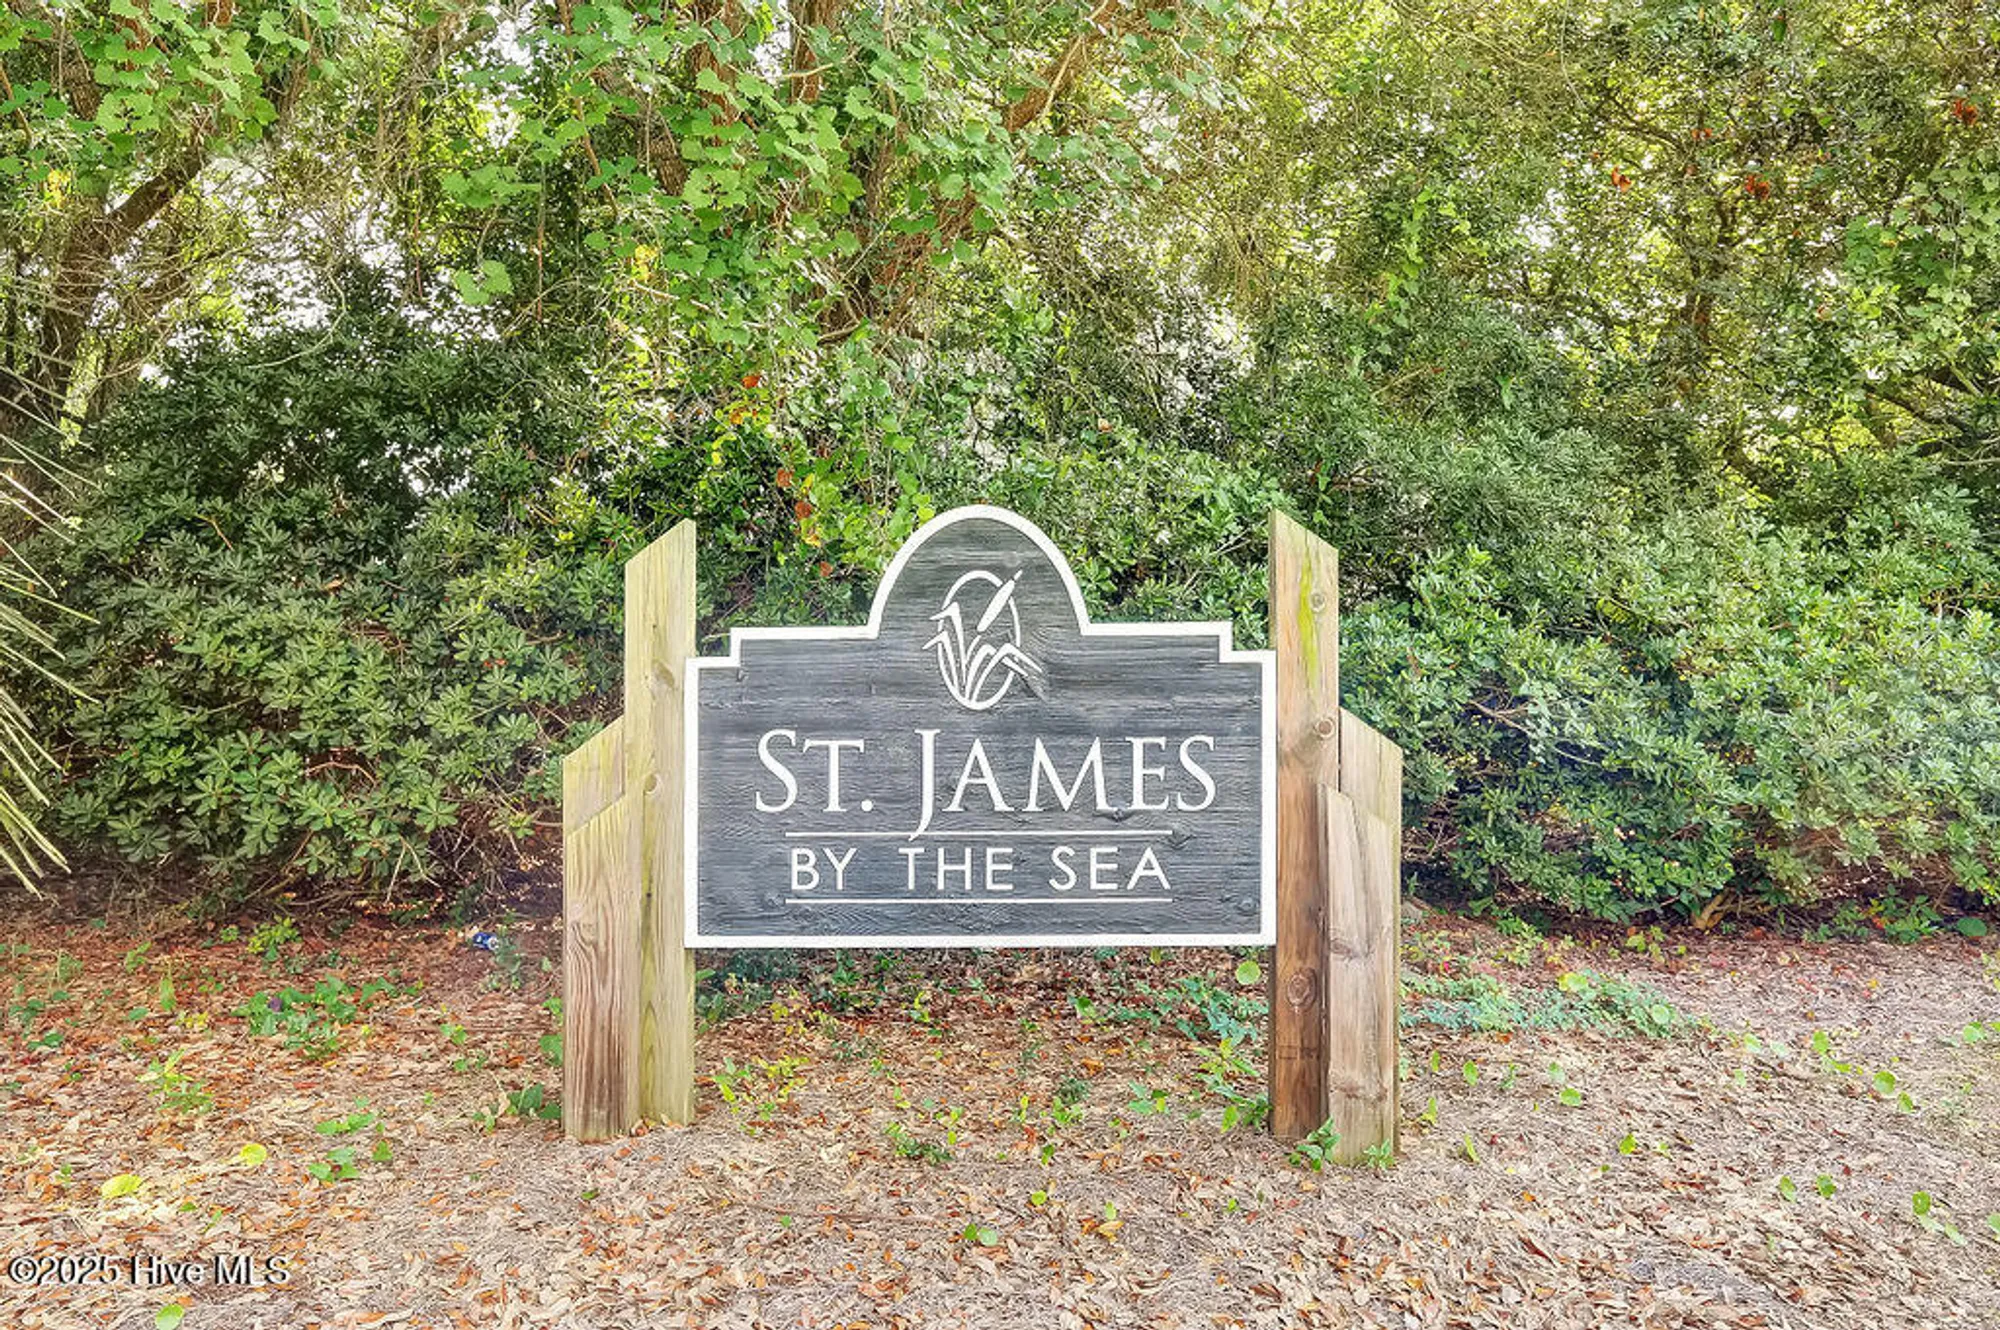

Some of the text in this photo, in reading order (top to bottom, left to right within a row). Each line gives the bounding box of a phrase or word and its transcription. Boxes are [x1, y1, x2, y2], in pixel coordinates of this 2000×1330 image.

[756, 728, 1217, 841] ST. JAMES
[791, 846, 1171, 890] BY THE SEA
